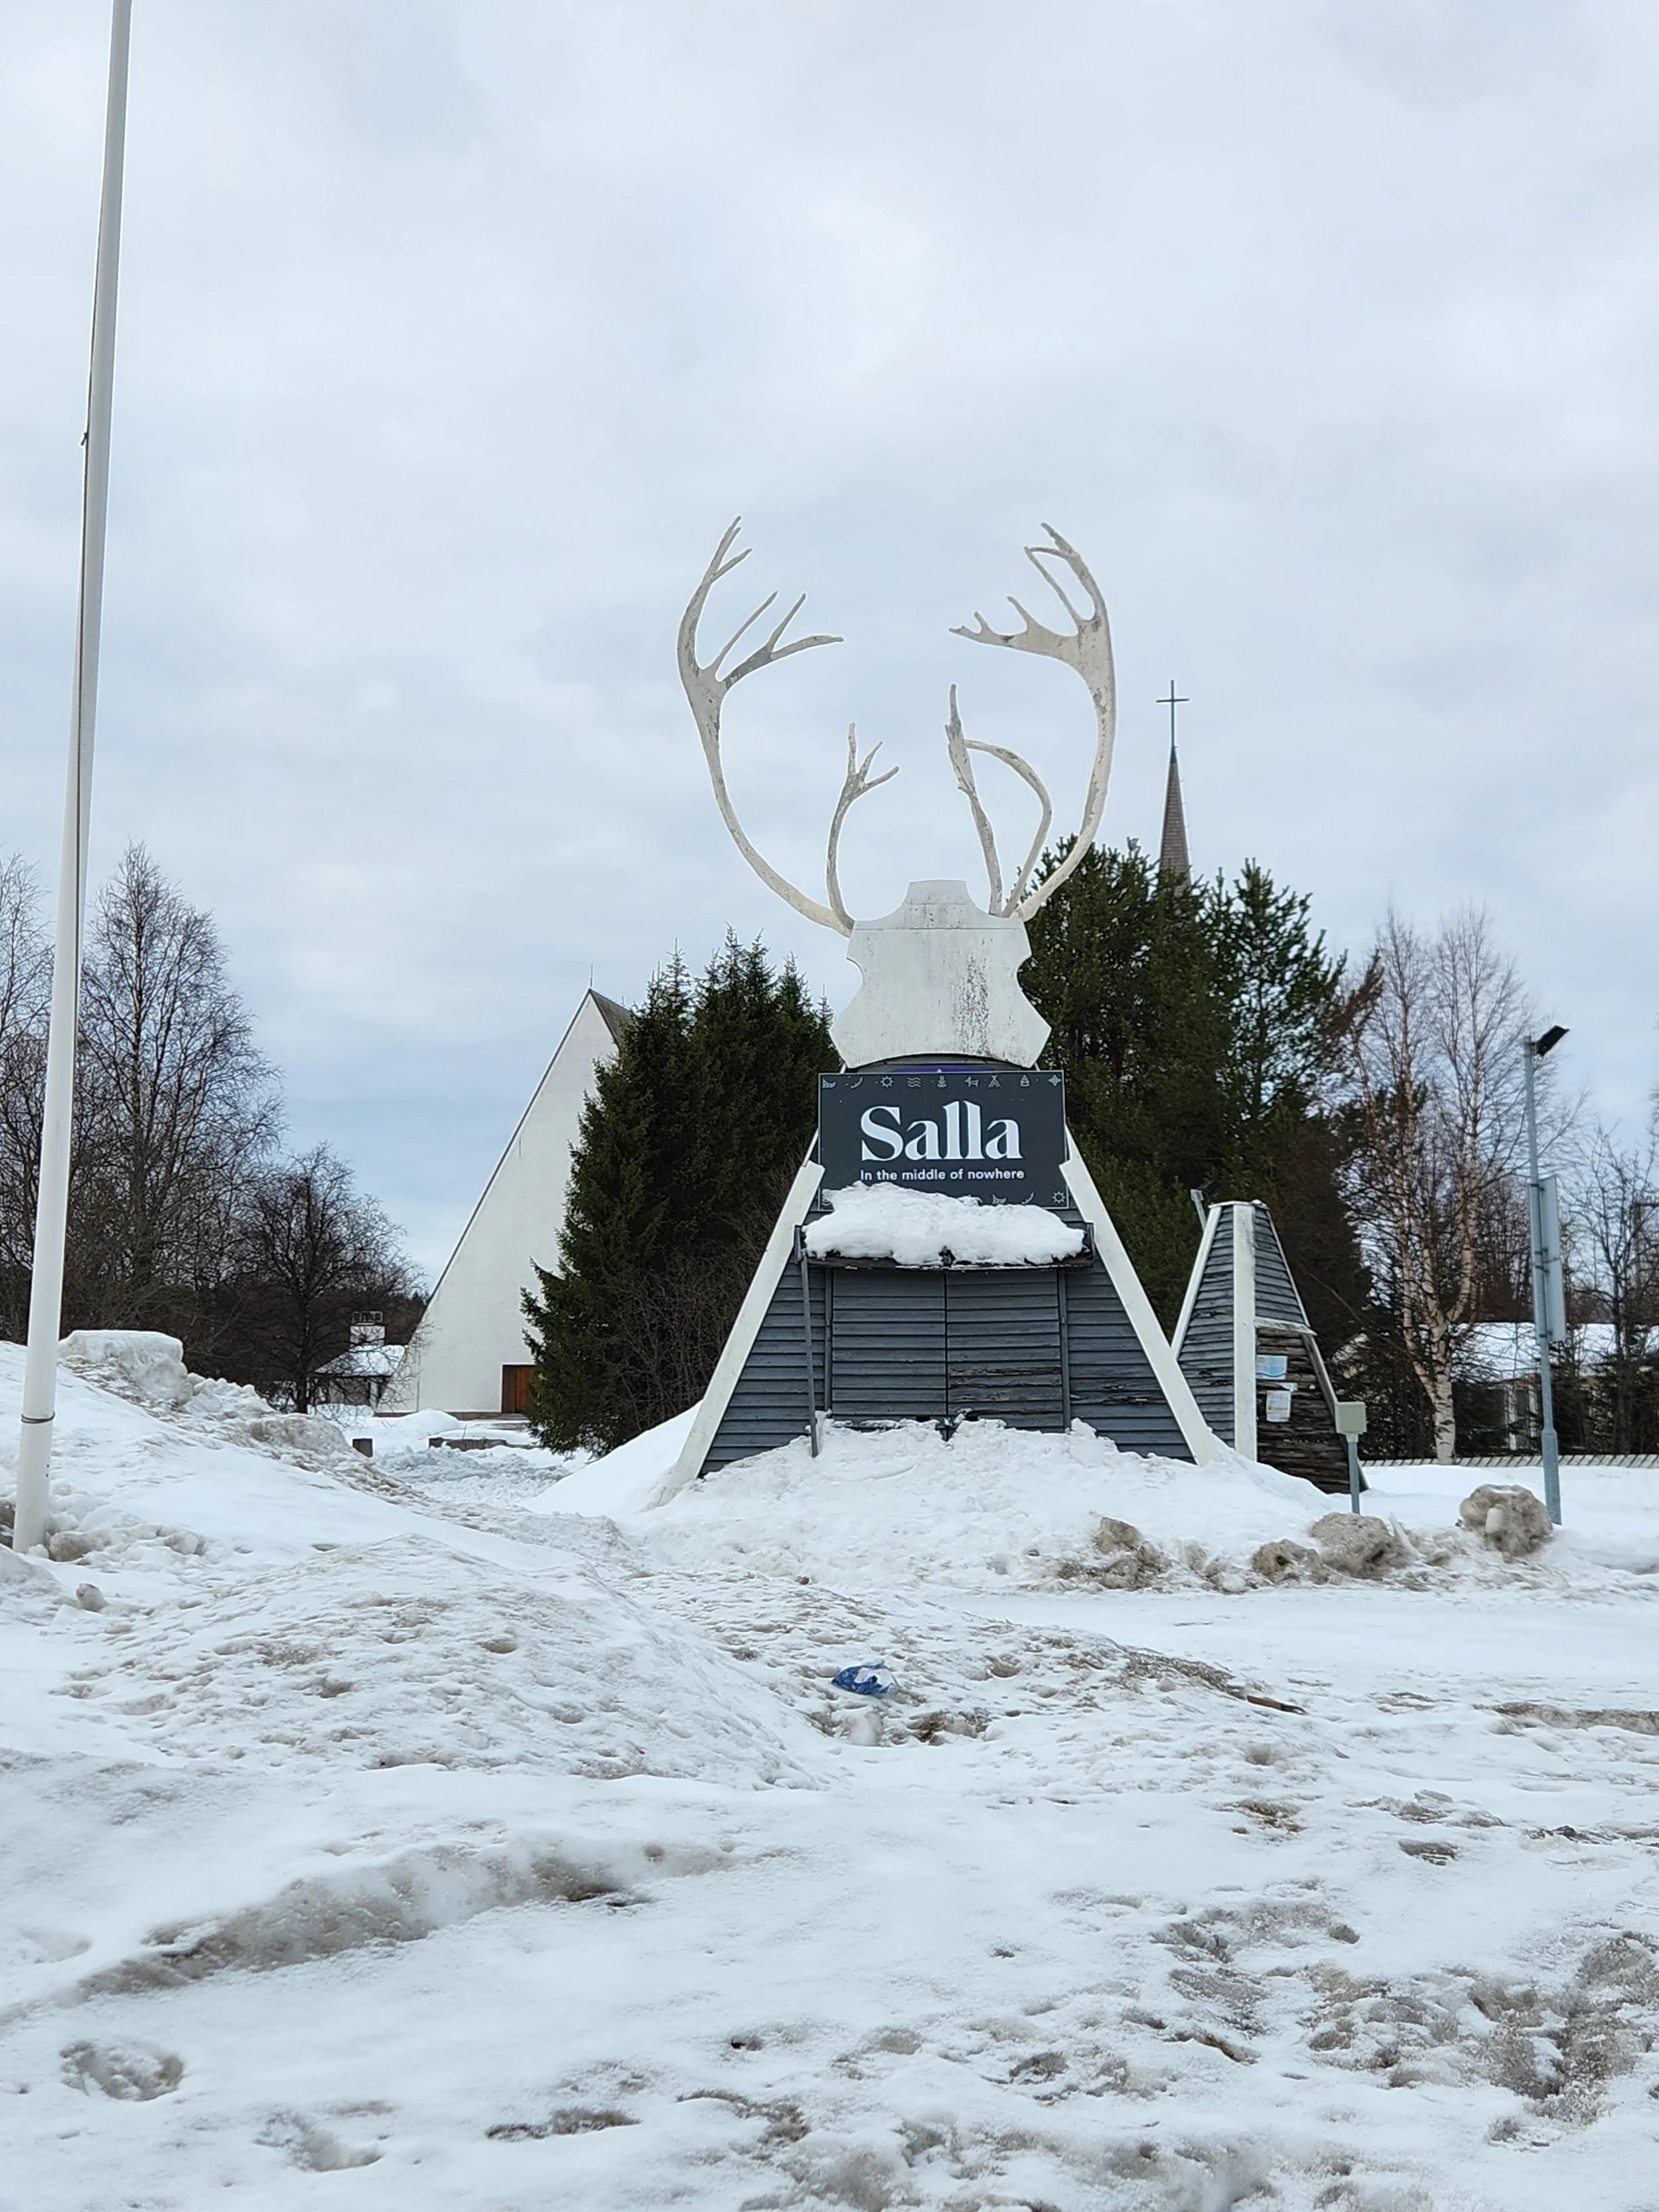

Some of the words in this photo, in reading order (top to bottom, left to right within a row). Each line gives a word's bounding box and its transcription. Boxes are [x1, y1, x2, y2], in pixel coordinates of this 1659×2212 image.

[861, 1100, 1024, 1161] Salla
[860, 1169, 873, 1180] In
[877, 1169, 897, 1180] the
[902, 1169, 946, 1181] middle
[950, 1168, 964, 1180] of
[968, 1168, 1025, 1179] nowhere
